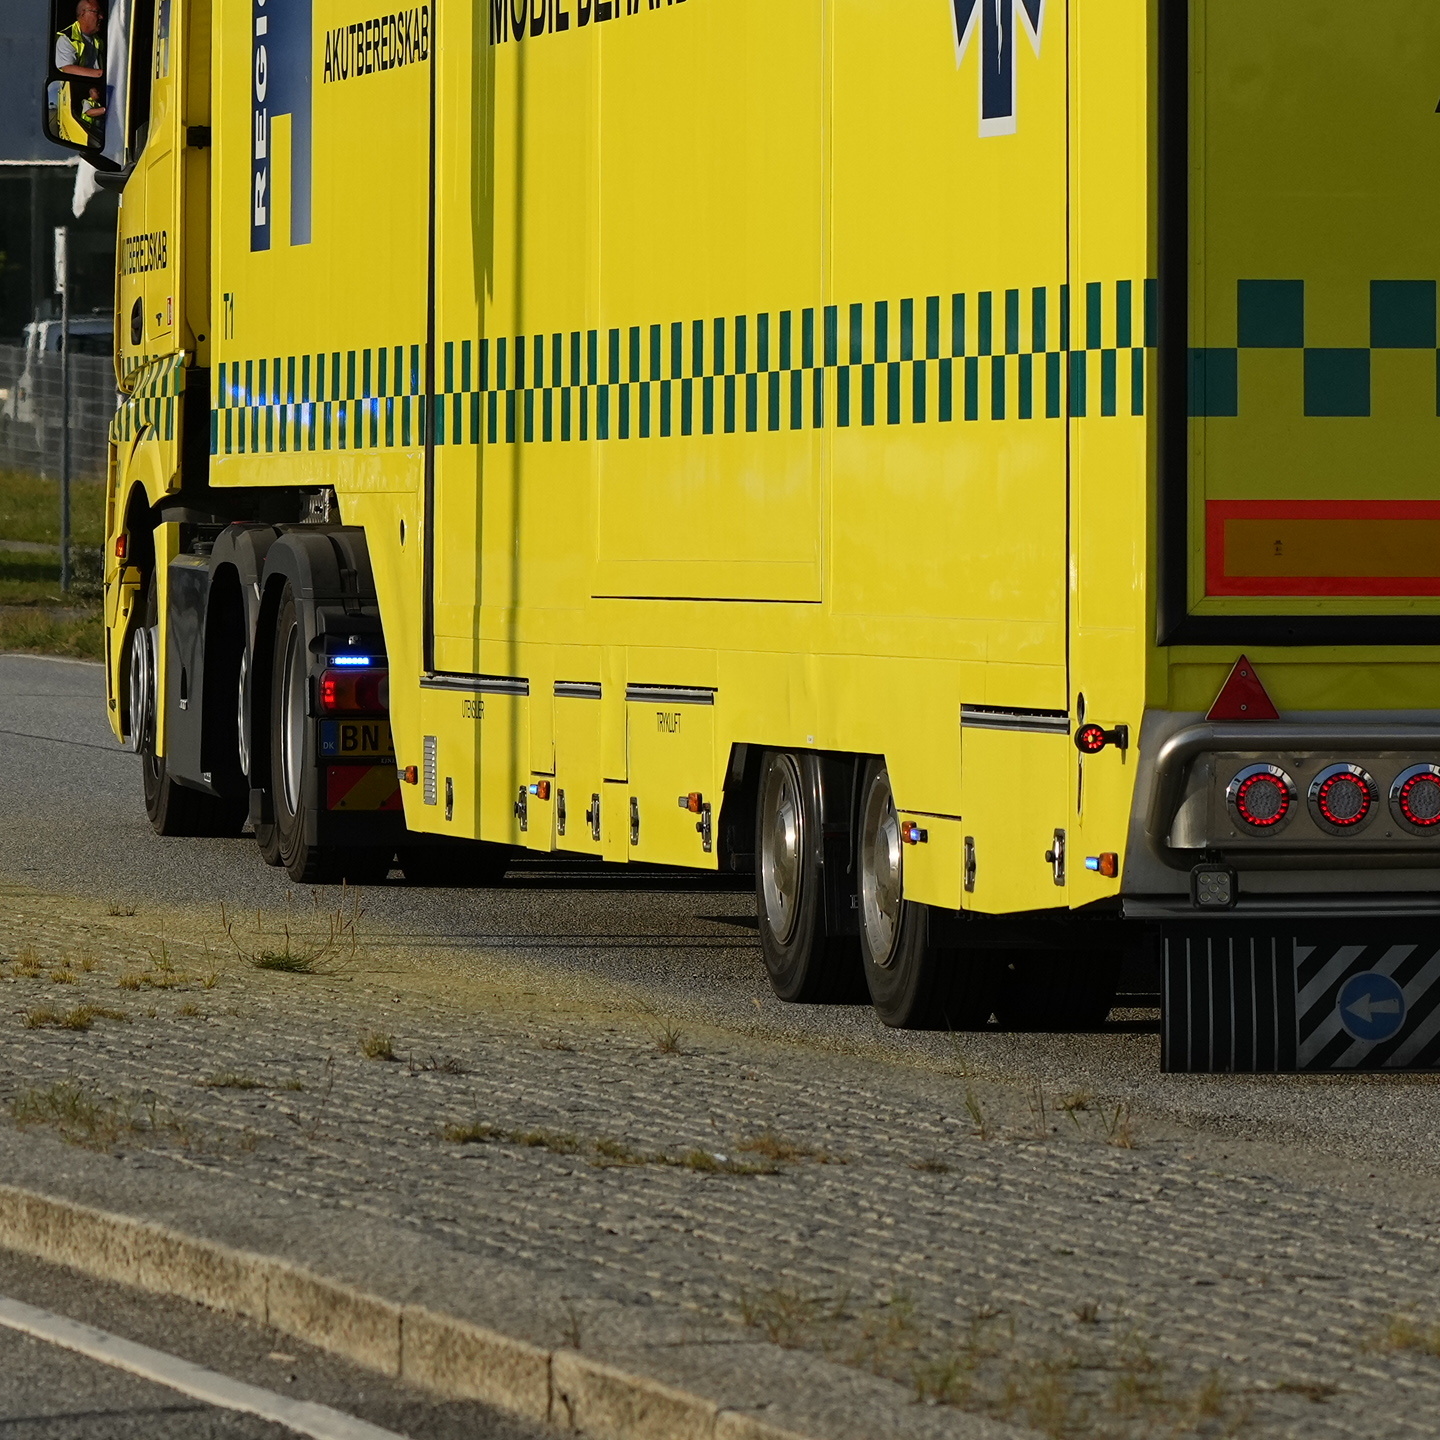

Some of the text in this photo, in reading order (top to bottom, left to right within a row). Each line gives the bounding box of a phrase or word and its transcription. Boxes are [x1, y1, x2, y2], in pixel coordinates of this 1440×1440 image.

[323, 5, 431, 84] AKUTBEREDSKAB
[224, 293, 233, 340] T1
[657, 712, 681, 733] TRYKLUFT
[323, 741, 335, 750] DK
[341, 725, 379, 751] BN
